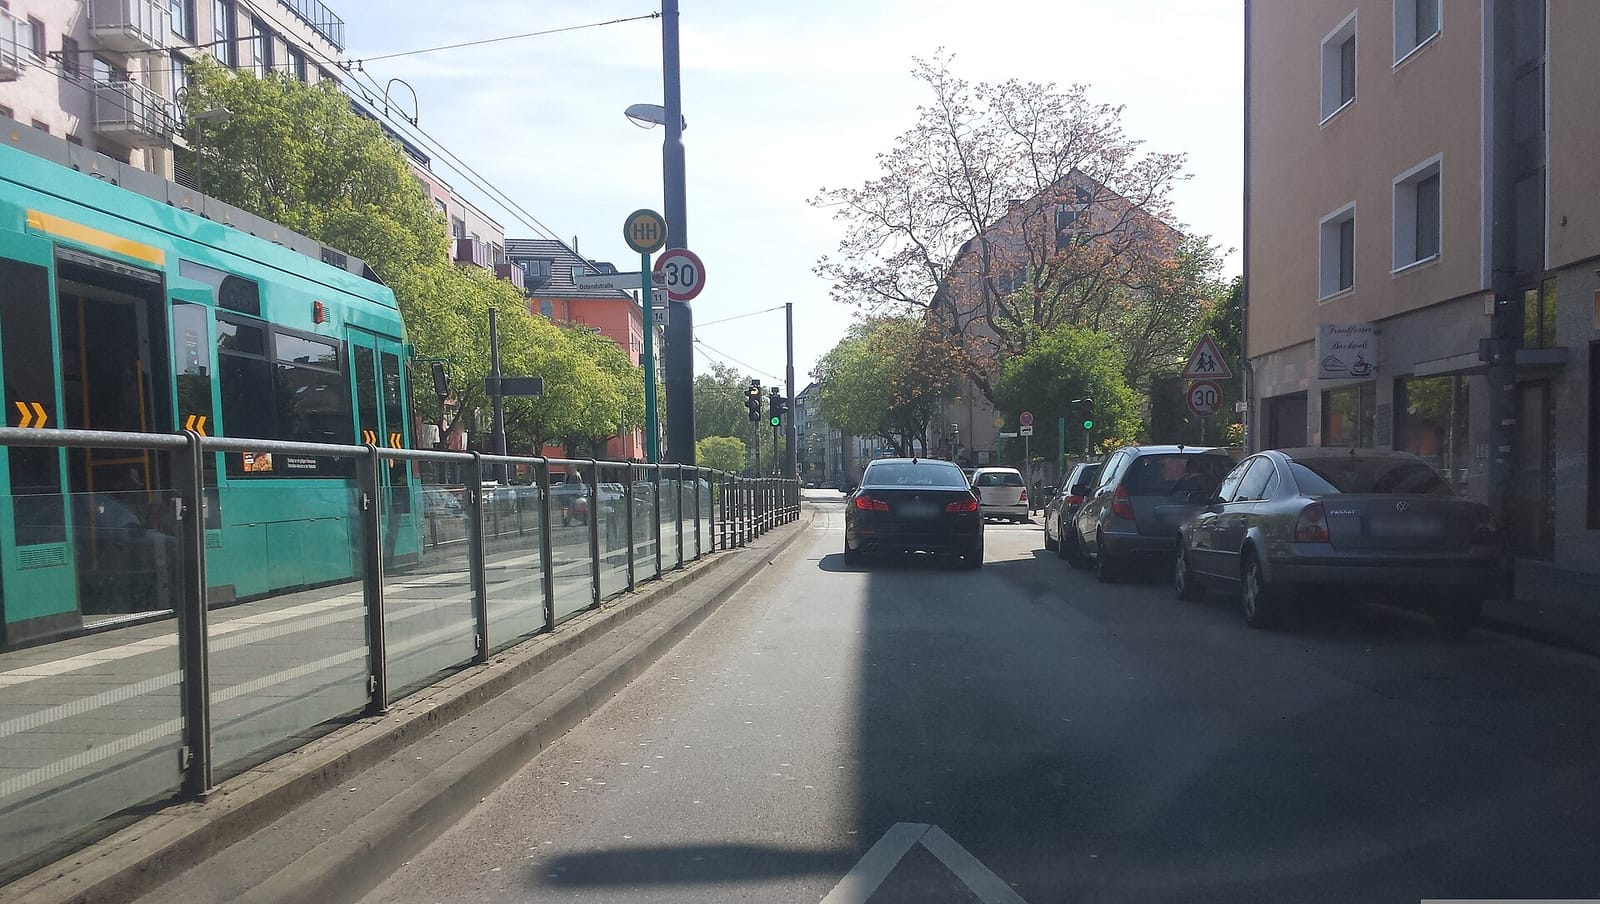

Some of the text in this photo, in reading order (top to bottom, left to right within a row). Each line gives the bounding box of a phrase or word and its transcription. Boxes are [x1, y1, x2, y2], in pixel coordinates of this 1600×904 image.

[633, 222, 657, 240] HH
[665, 262, 695, 287] 30
[654, 294, 662, 302] 11
[654, 312, 663, 320] 14
[1194, 390, 1214, 407] 30
